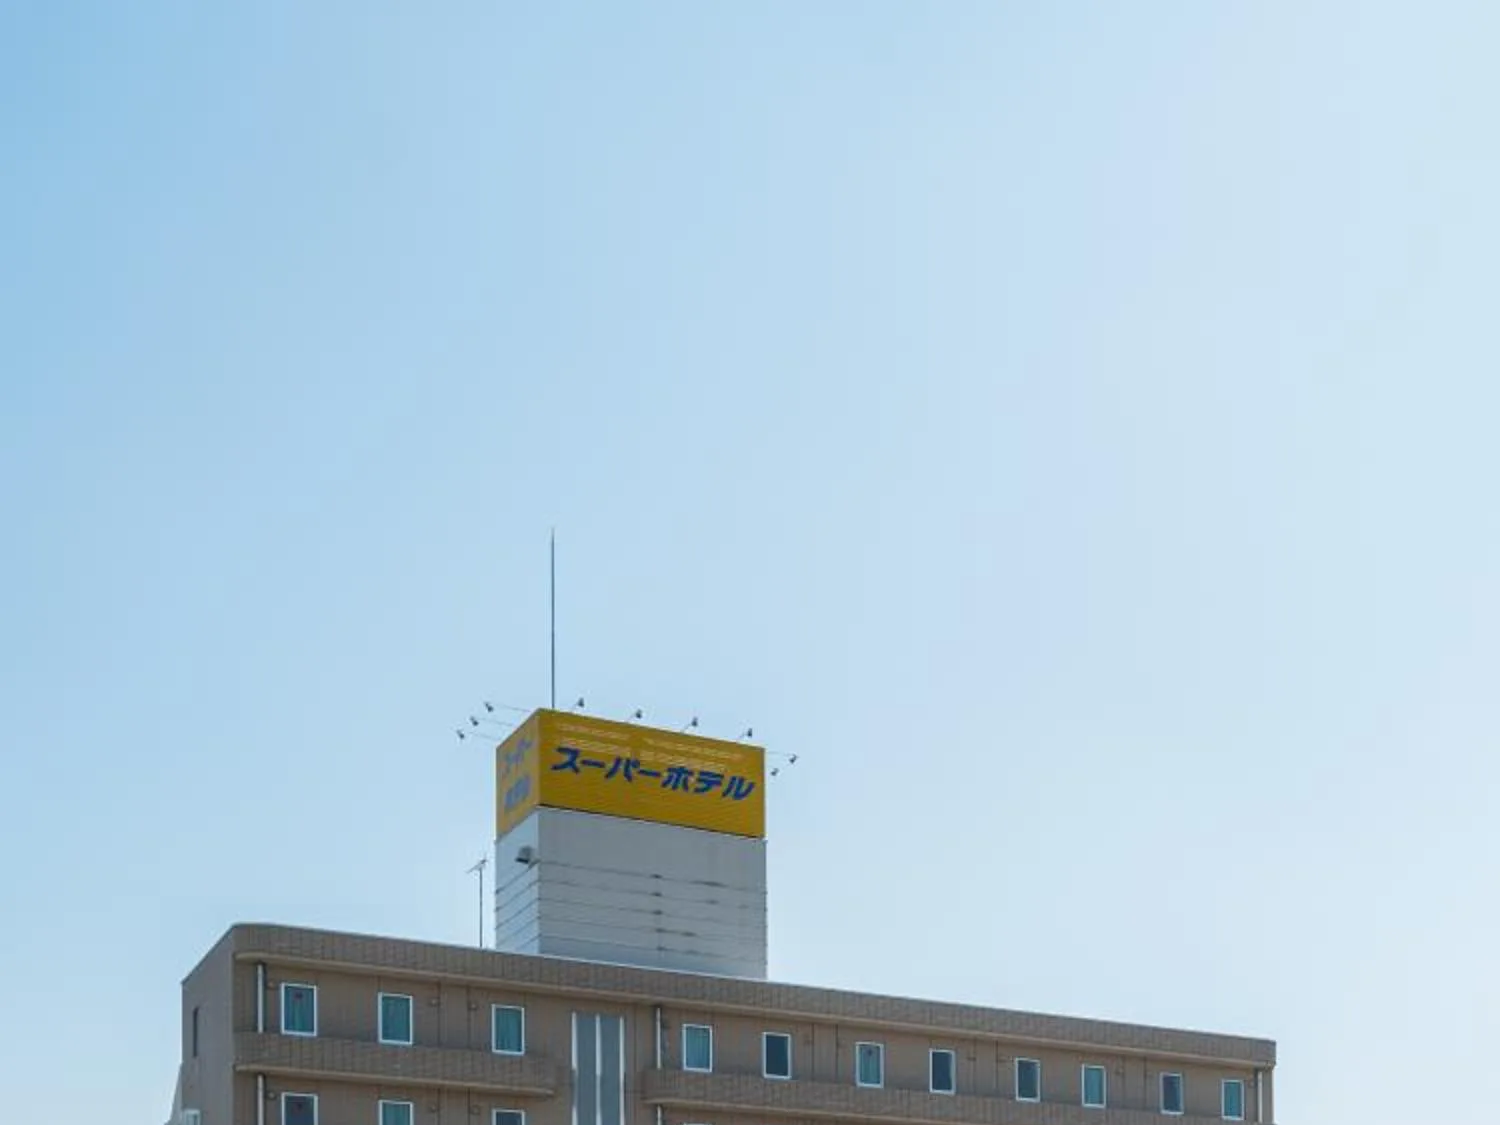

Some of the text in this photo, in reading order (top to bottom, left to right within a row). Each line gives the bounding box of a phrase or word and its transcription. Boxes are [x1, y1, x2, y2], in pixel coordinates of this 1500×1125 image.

[550, 747, 756, 801] スーパーホテル
